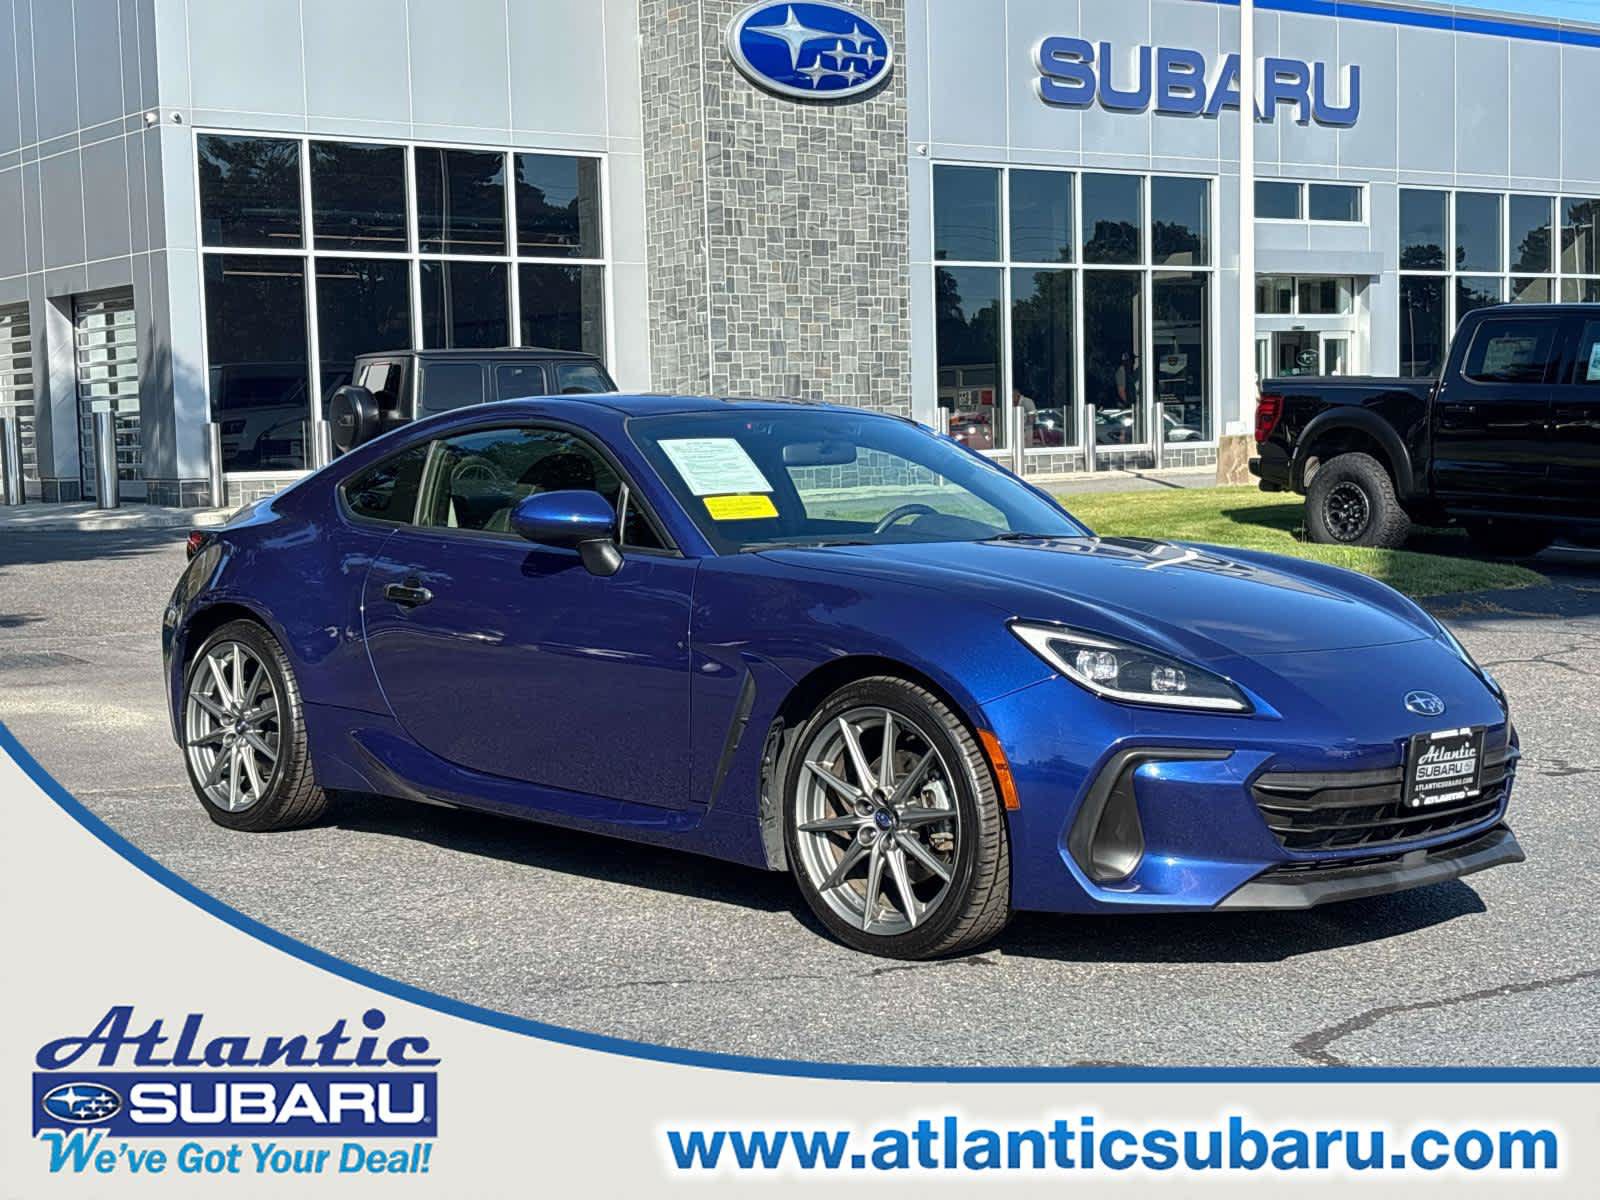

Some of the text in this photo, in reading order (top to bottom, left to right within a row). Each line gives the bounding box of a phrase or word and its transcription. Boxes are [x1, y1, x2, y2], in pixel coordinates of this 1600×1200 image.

[1036, 36, 1361, 128] SUBARU
[1419, 742, 1476, 764] Atlantic
[1417, 762, 1463, 779] SUBARU
